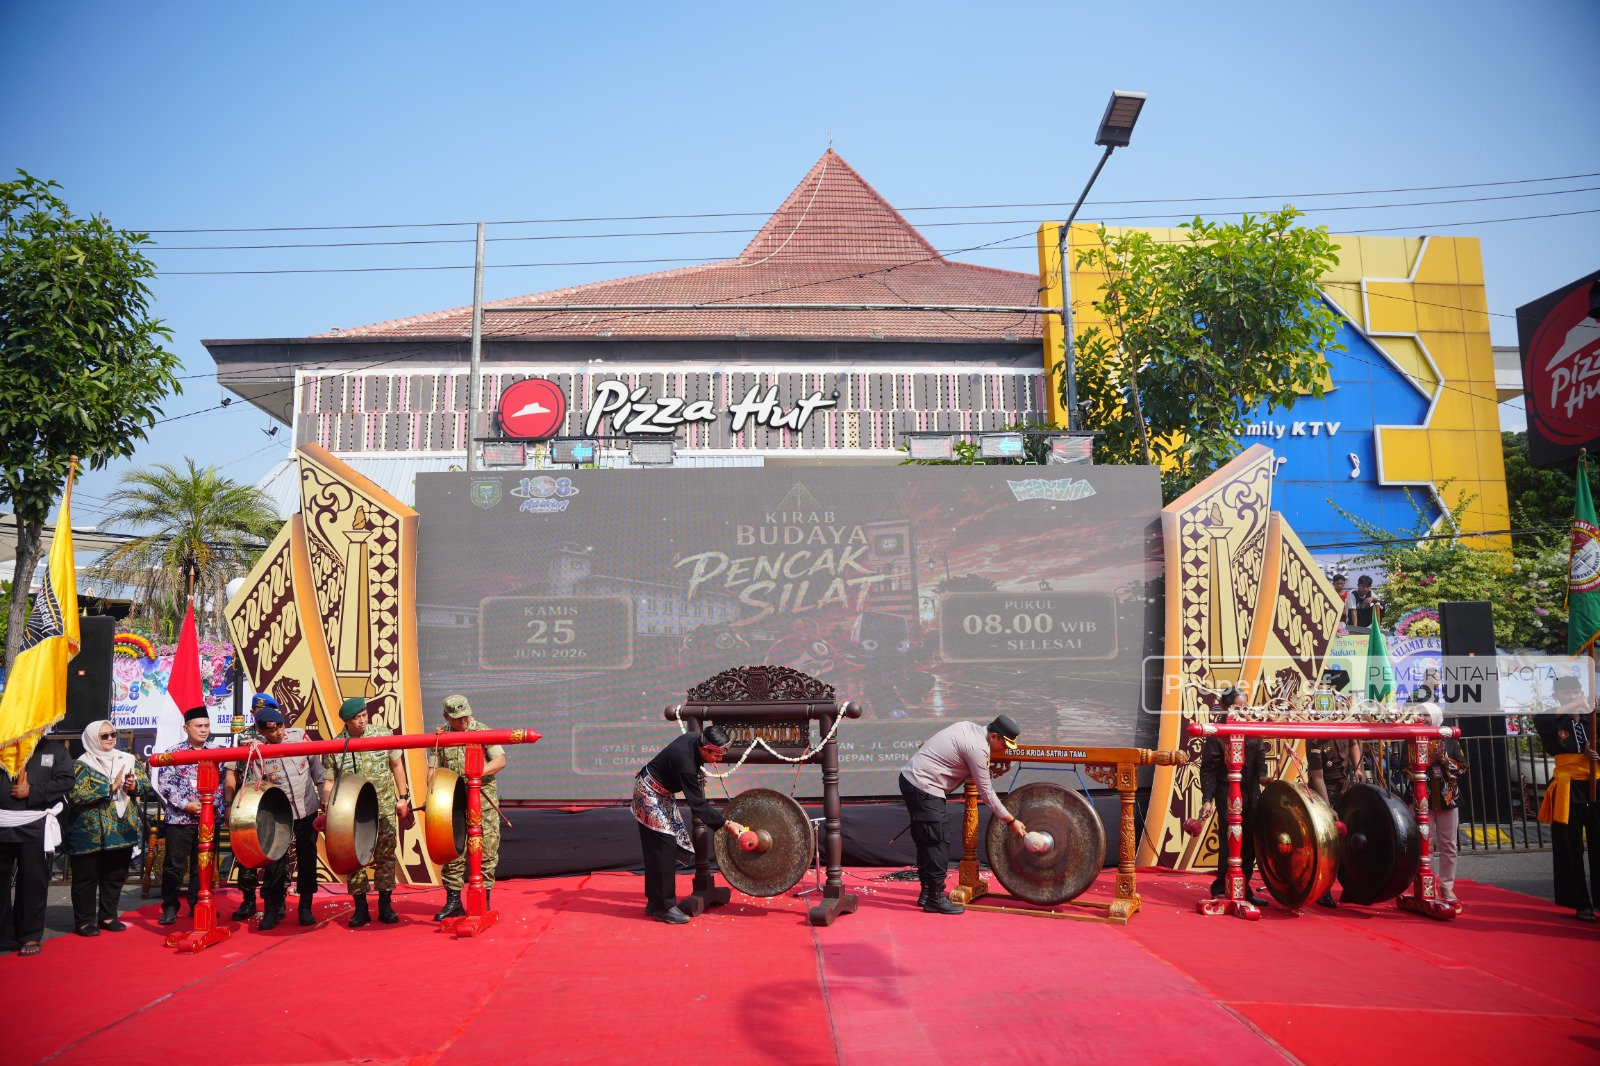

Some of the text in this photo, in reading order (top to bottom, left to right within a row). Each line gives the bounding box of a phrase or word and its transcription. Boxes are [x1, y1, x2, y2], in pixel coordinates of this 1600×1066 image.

[1564, 378, 1600, 419] Hu
[584, 379, 837, 437] Pizza Hut
[1234, 420, 1341, 439] mily KTV
[766, 511, 836, 523] KIRAB
[736, 525, 869, 546] BUDAYA
[674, 546, 876, 600] PENCAK
[524, 606, 579, 616] KAMIS
[730, 573, 908, 640] SILAT
[1004, 600, 1056, 610] PUKUL
[962, 613, 1097, 635] 08.00 WIB
[525, 619, 577, 644] 25
[1007, 638, 1082, 650] SELESAI
[1391, 639, 1424, 656] SELAMAT
[513, 648, 586, 658] JUNI 2026
[1330, 648, 1356, 657] Sukses
[112, 703, 139, 715] adiun
[118, 716, 150, 726] MADIUN
[152, 716, 158, 726] K
[727, 727, 752, 741] OTA
[753, 727, 801, 741] MADIUN
[601, 745, 636, 753] START
[1026, 748, 1045, 757] KRIDA
[1046, 749, 1068, 758] SATRIA
[1069, 750, 1087, 758] TAMA
[838, 754, 874, 763] DEPAN
[878, 753, 909, 762] SMPN
